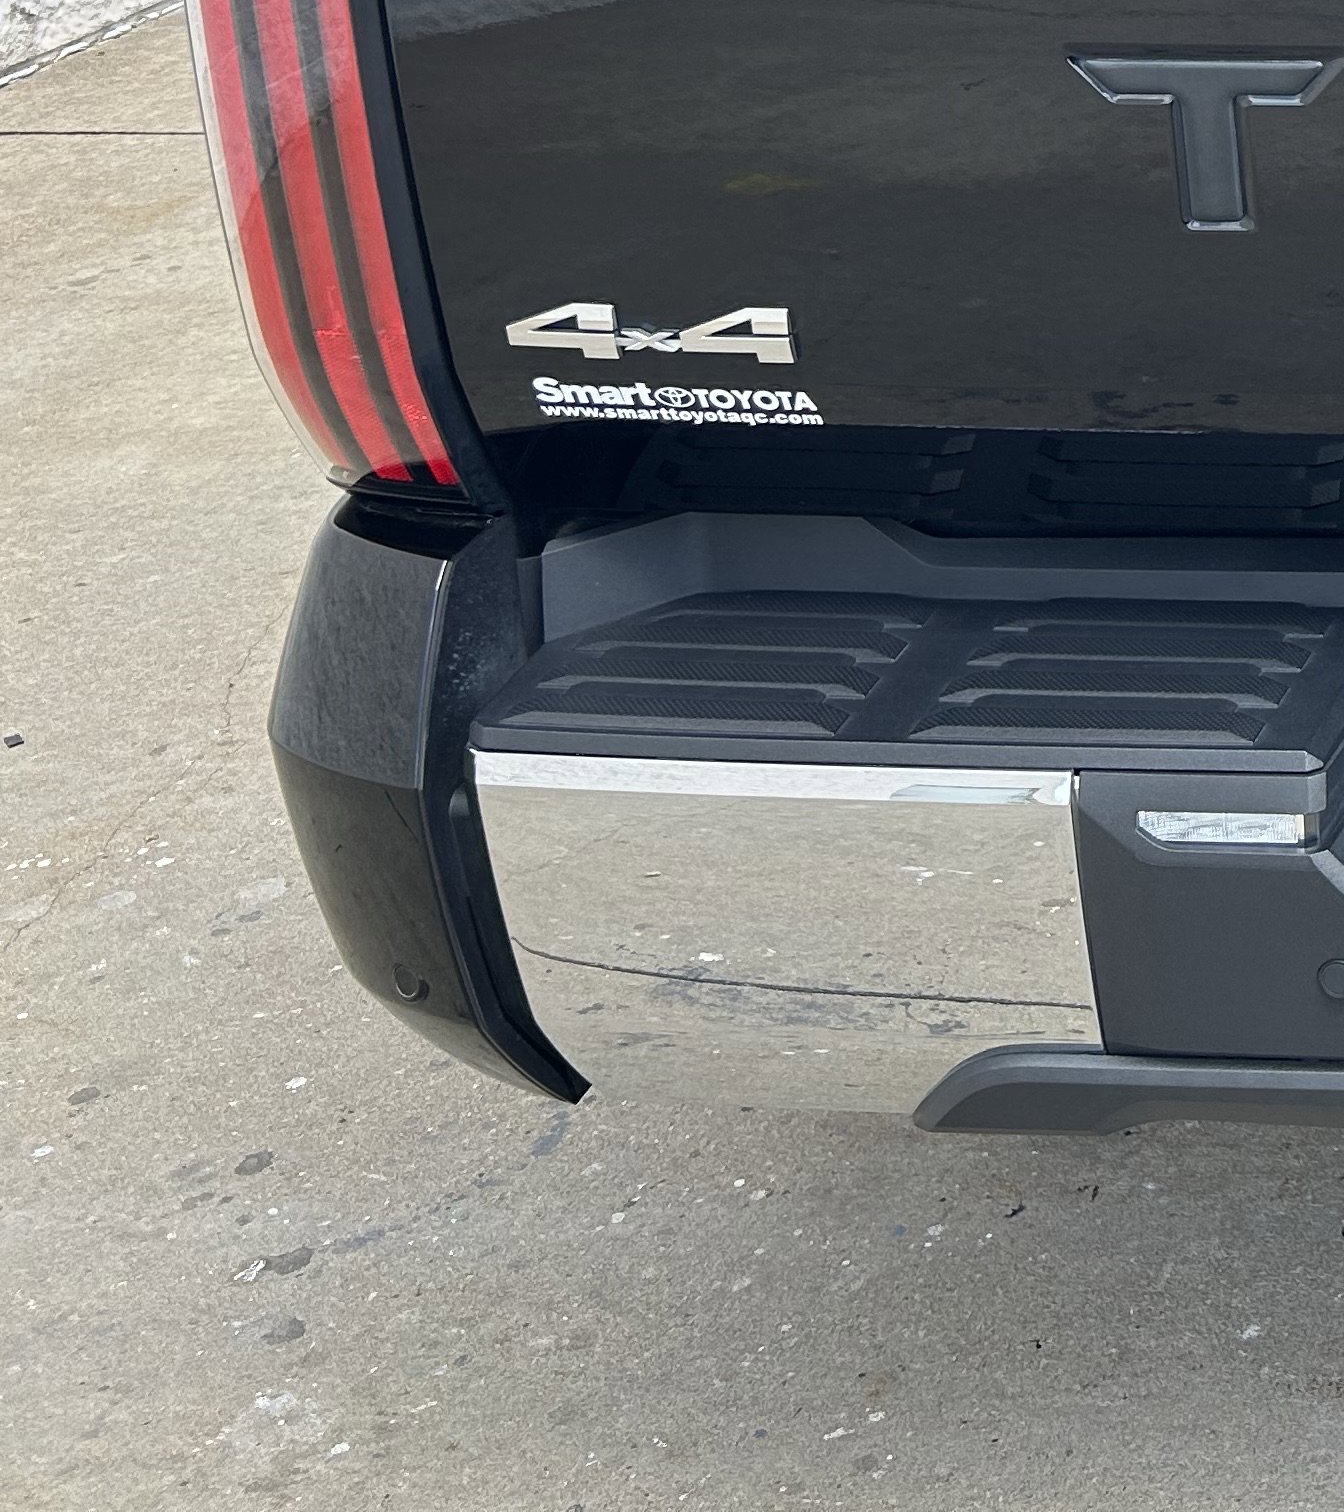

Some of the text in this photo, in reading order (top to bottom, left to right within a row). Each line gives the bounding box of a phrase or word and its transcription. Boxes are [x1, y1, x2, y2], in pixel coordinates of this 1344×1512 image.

[506, 302, 797, 363] 4x4
[532, 377, 817, 412] Smart TOYOTA
[541, 404, 823, 426] www.smarttoyotaqc.com
